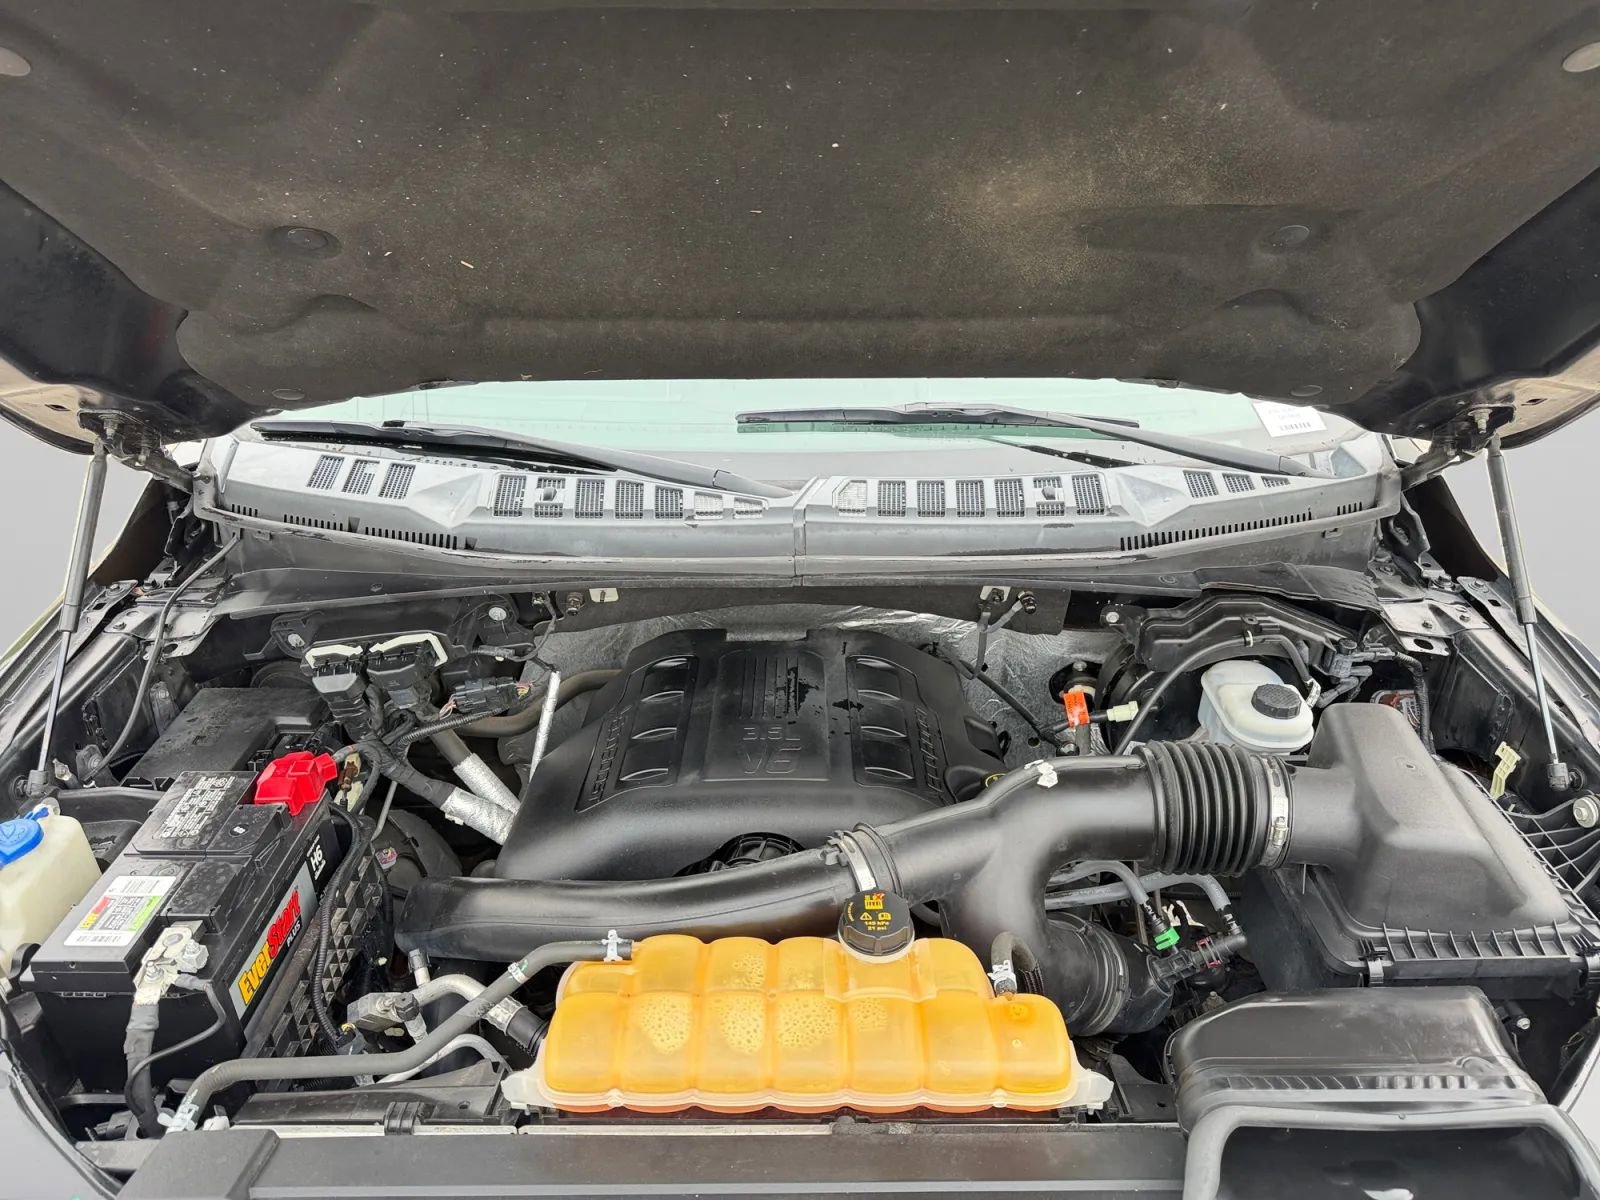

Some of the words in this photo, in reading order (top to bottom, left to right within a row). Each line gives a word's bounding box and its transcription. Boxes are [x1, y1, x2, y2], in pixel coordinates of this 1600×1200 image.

[740, 744, 802, 775] V6
[310, 844, 324, 872] H6
[238, 889, 302, 1006] EverStart
[286, 919, 302, 948] PLUS
